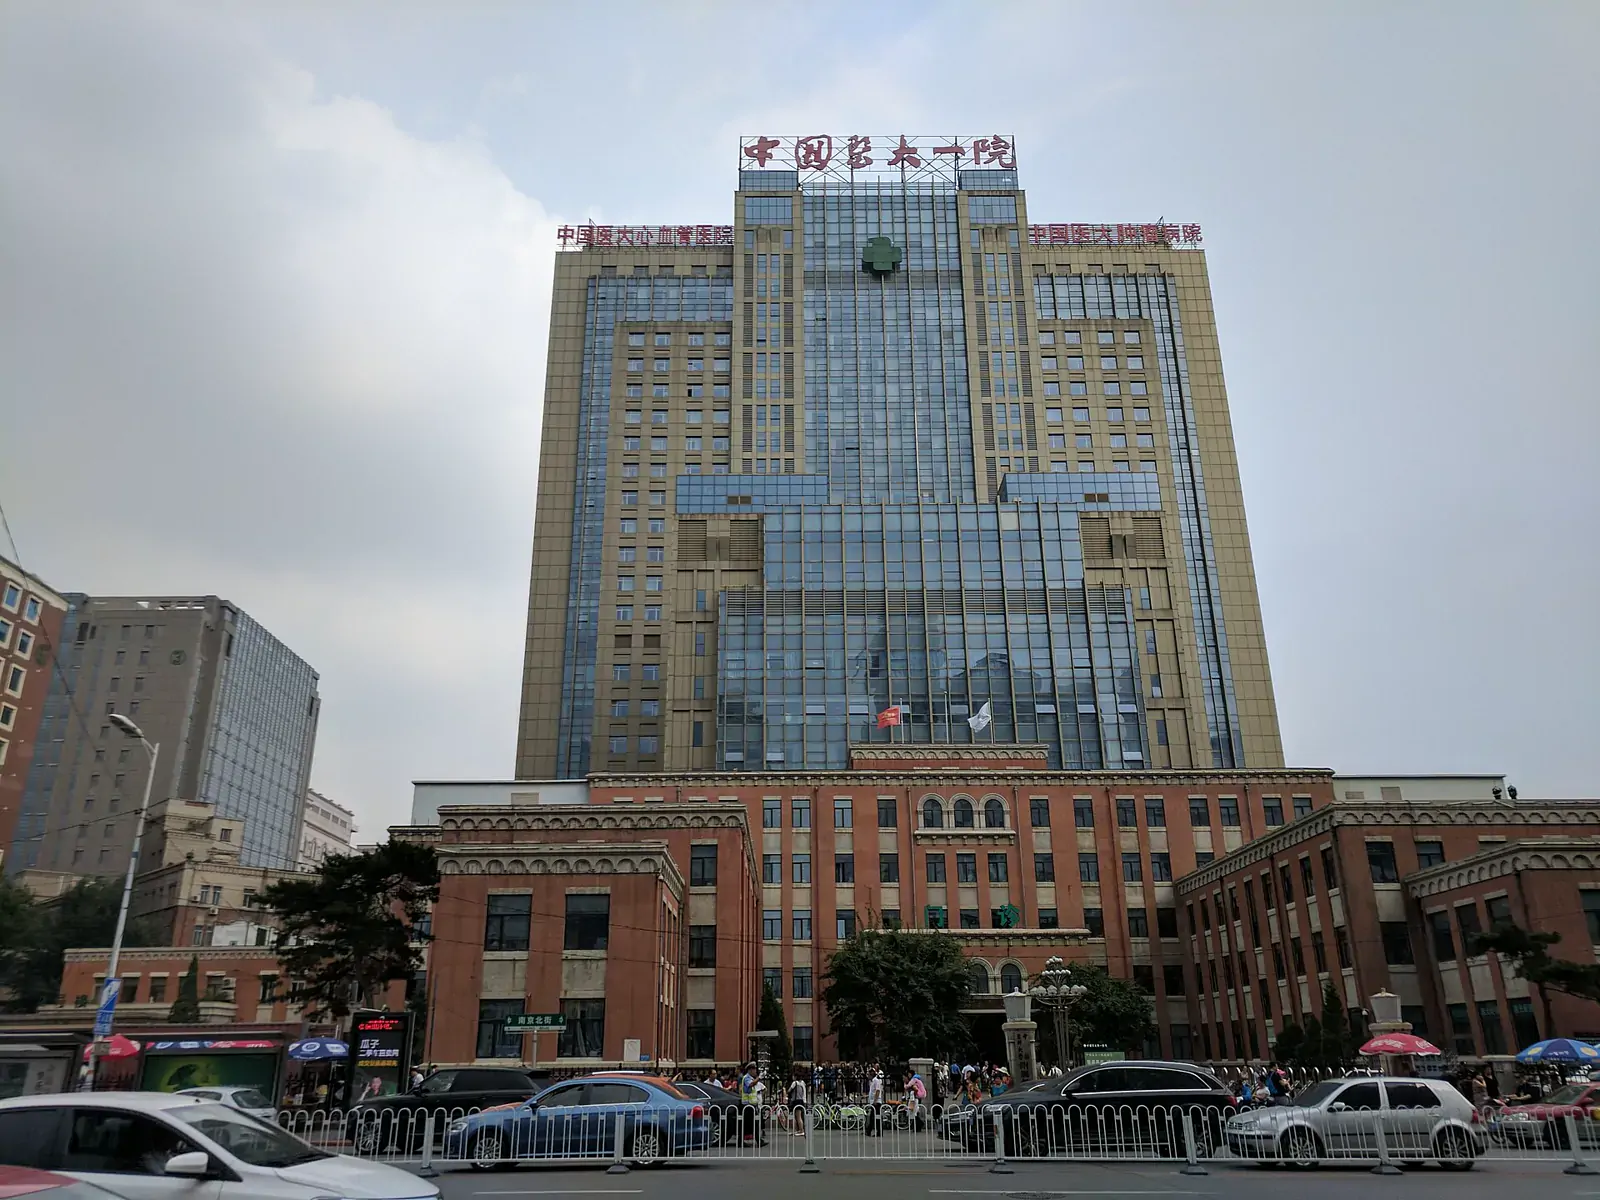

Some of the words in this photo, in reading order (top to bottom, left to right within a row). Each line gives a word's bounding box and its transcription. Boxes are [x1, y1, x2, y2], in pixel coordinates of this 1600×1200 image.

[557, 224, 735, 246] 中国医大心血管医院
[517, 1015, 552, 1025] 南京北街
[359, 1039, 380, 1049] 瓜子
